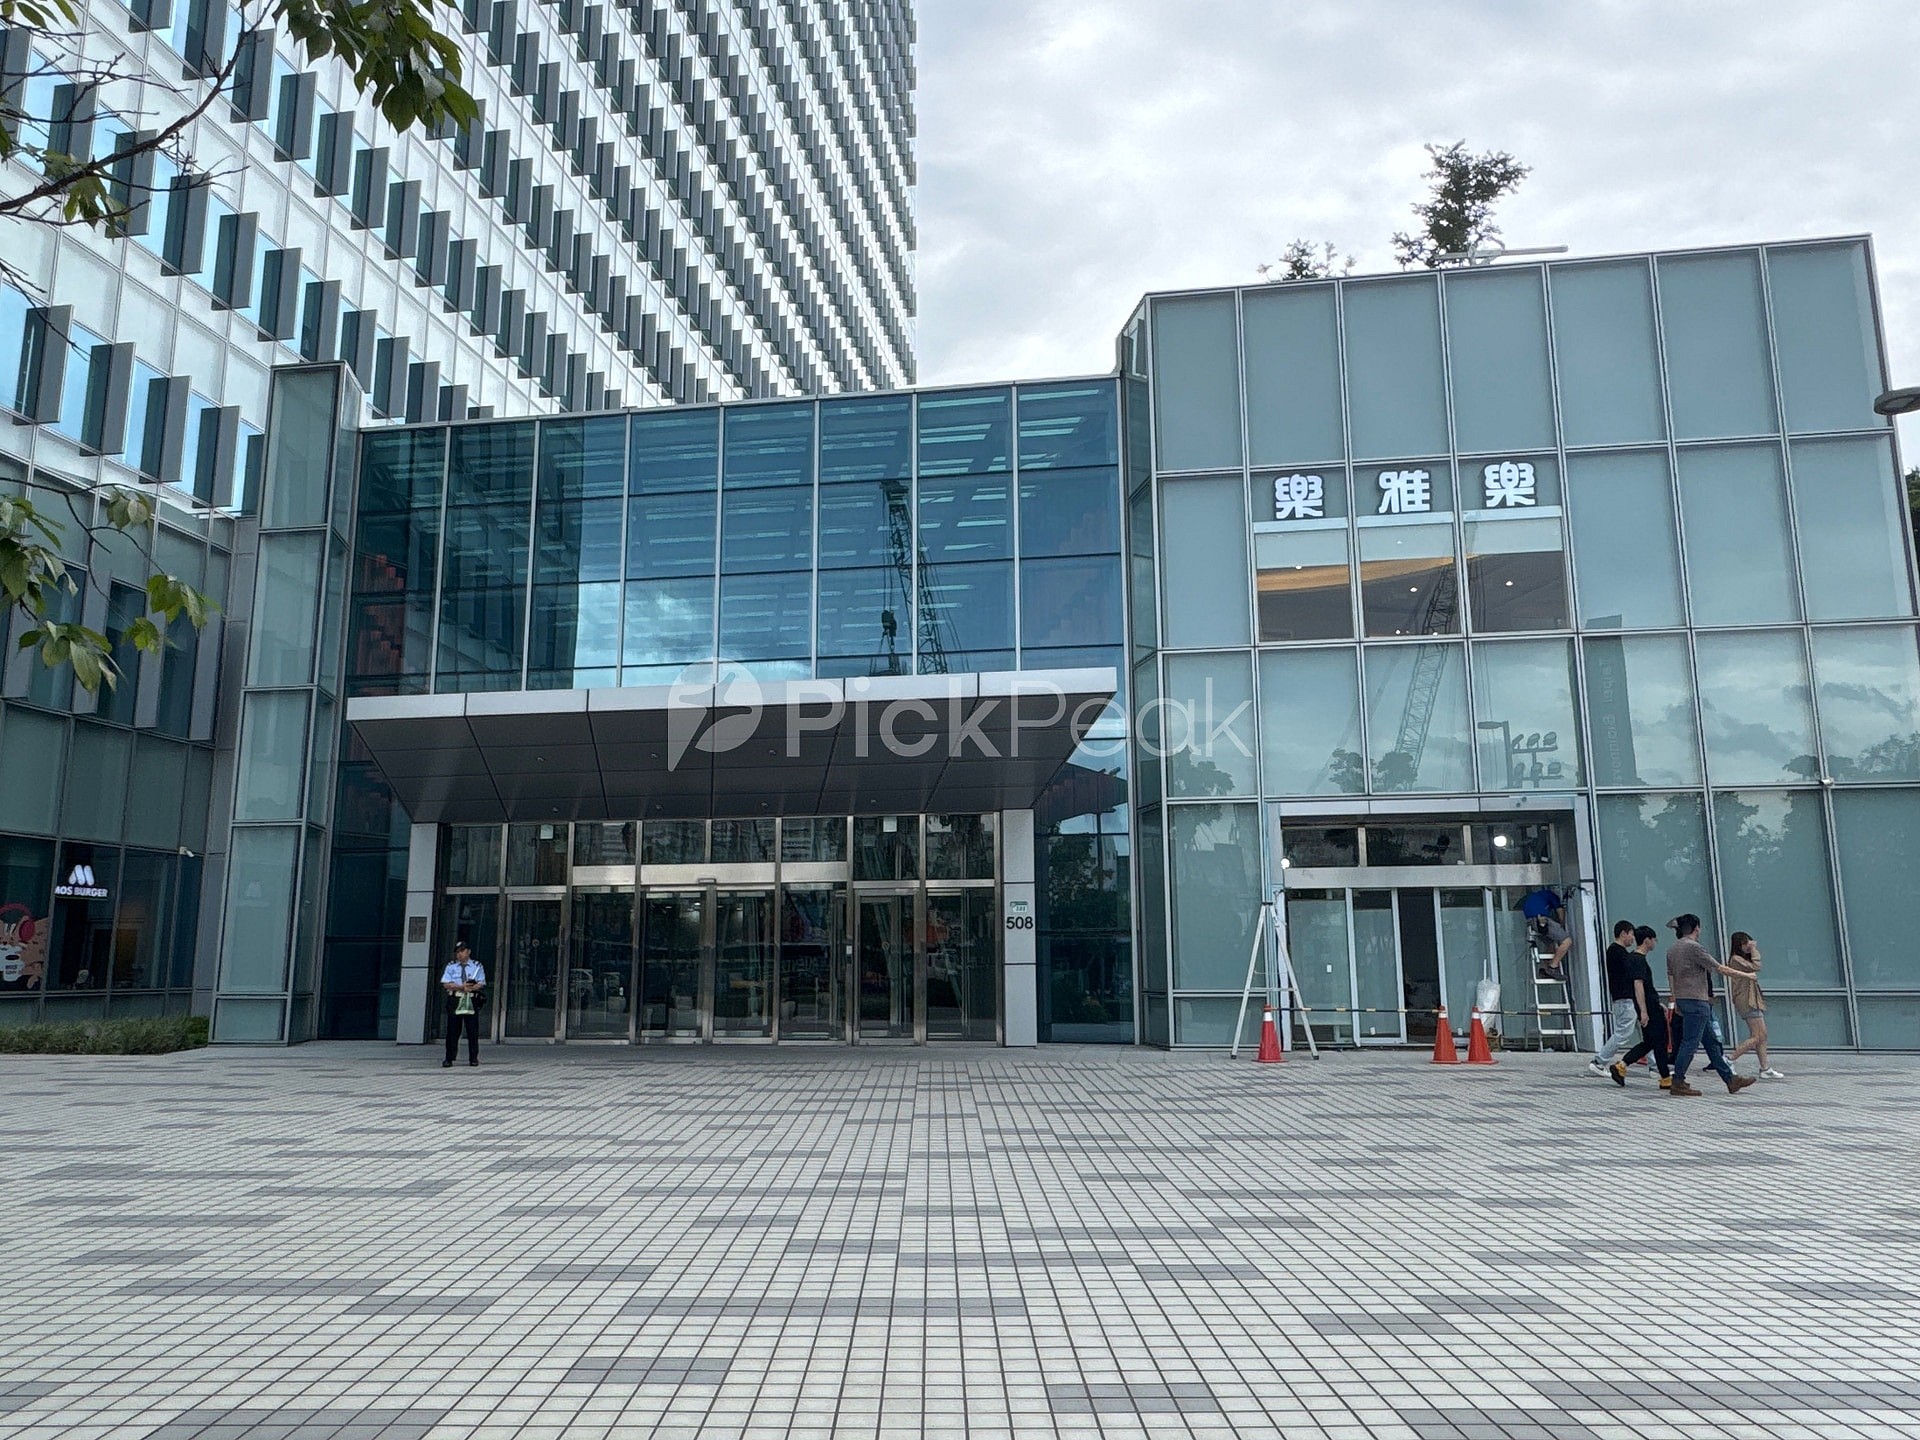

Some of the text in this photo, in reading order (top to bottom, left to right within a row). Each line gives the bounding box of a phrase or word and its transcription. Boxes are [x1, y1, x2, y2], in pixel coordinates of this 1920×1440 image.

[1274, 461, 1536, 519] 樂雅樂
[74, 887, 108, 897] BURGER
[1006, 916, 1034, 930] 508
